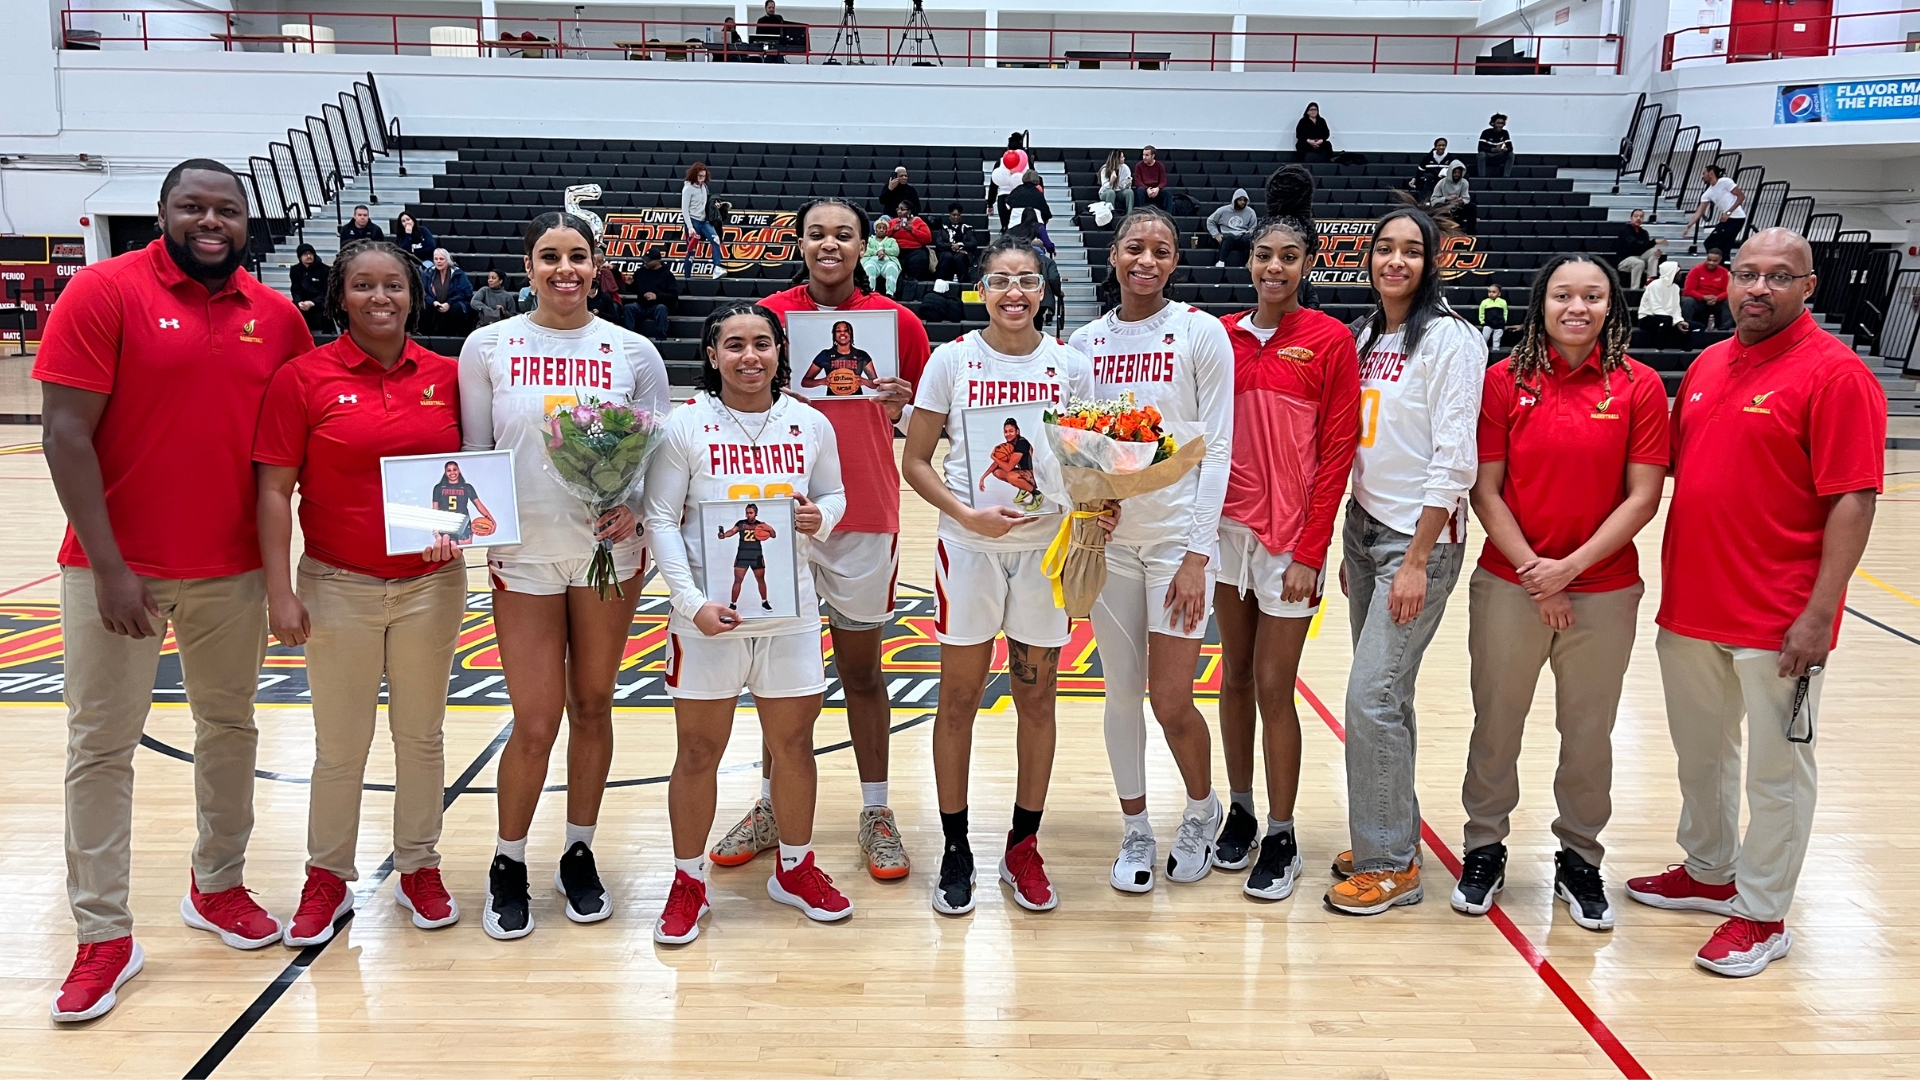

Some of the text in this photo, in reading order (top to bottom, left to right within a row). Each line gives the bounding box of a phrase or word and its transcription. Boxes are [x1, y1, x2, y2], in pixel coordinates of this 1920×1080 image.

[1836, 83, 1898, 97] FLAVOR
[1836, 94, 1920, 109] THE FIREBI
[730, 214, 745, 224] OF
[748, 215, 770, 225] THE
[1341, 272, 1357, 282] OF
[510, 356, 612, 391] FIREBIRDS
[1094, 352, 1174, 385] FIREBIRDS
[968, 380, 1060, 407] FIREBIRDS
[708, 443, 805, 476] FIREBIRDS
[448, 495, 457, 510] 5
[743, 529, 756, 541] 22
[1794, 681, 1807, 713] UNDER
